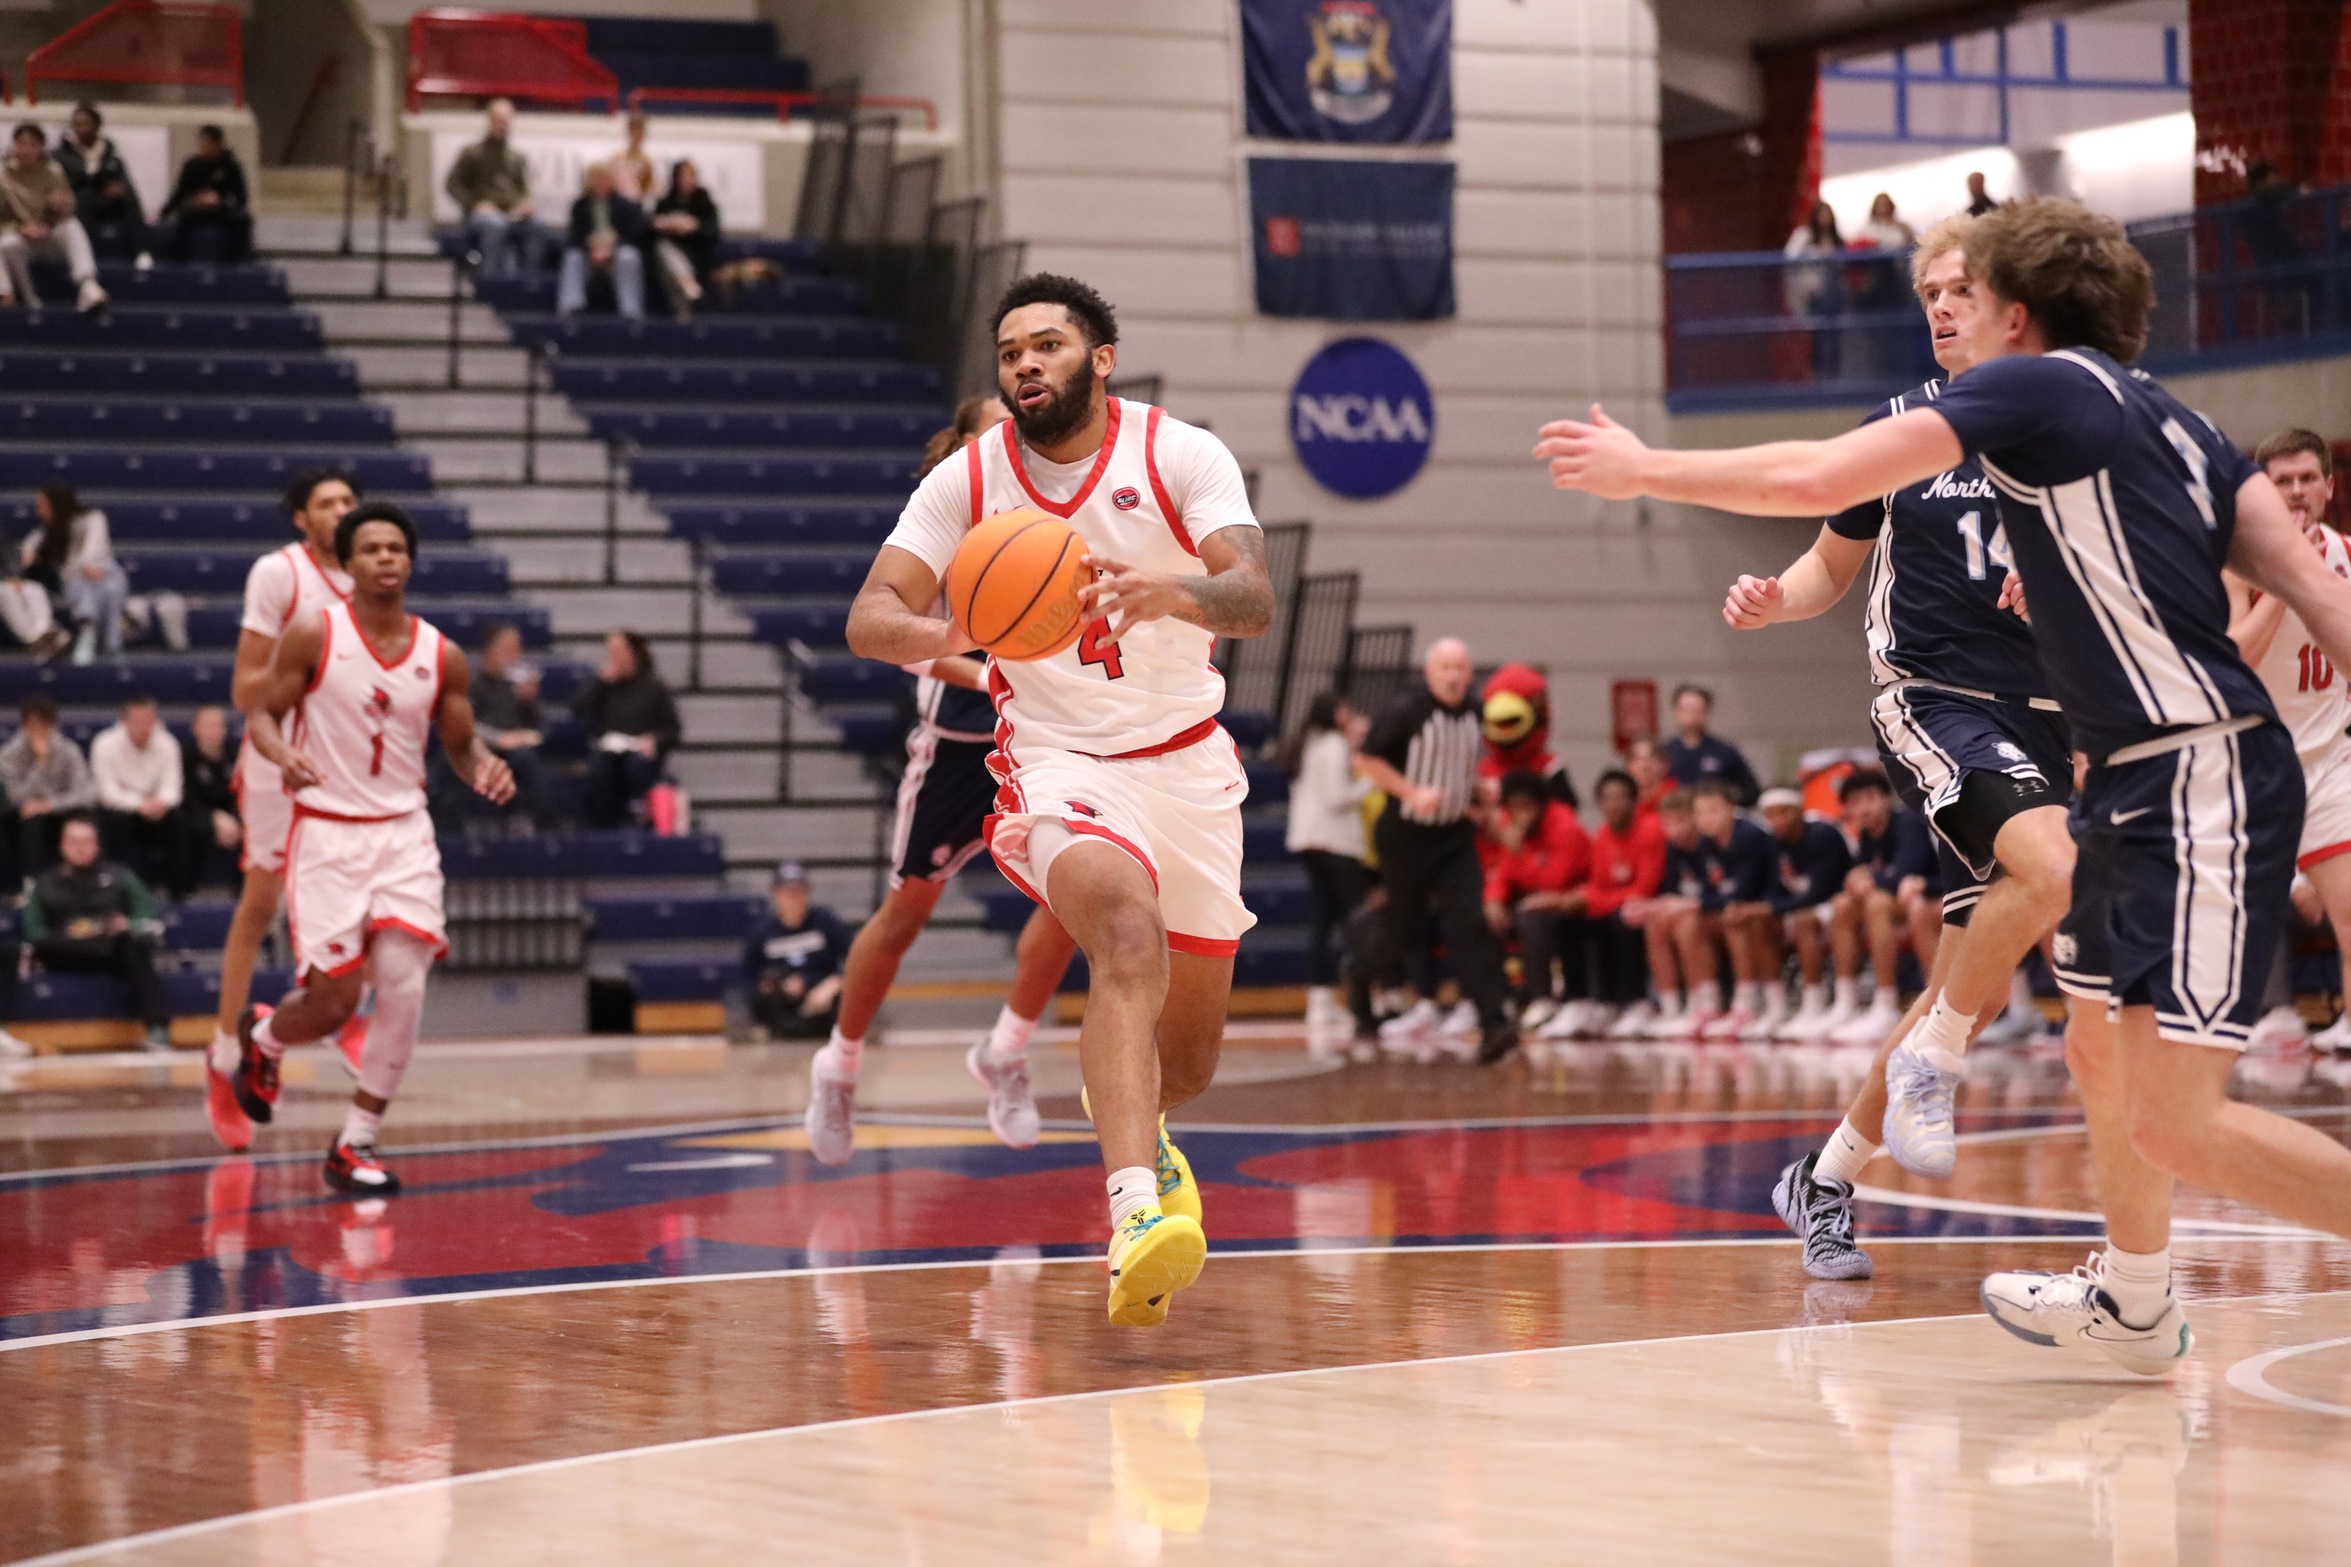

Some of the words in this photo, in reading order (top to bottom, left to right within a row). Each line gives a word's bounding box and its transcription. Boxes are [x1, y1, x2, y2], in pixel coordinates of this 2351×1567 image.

[1298, 394, 1429, 442] NCAA
[1921, 471, 1997, 500] North
[1957, 510, 2018, 580] 14
[1077, 612, 1124, 680] 4
[2297, 643, 2334, 693] 10
[369, 732, 384, 778] 1
